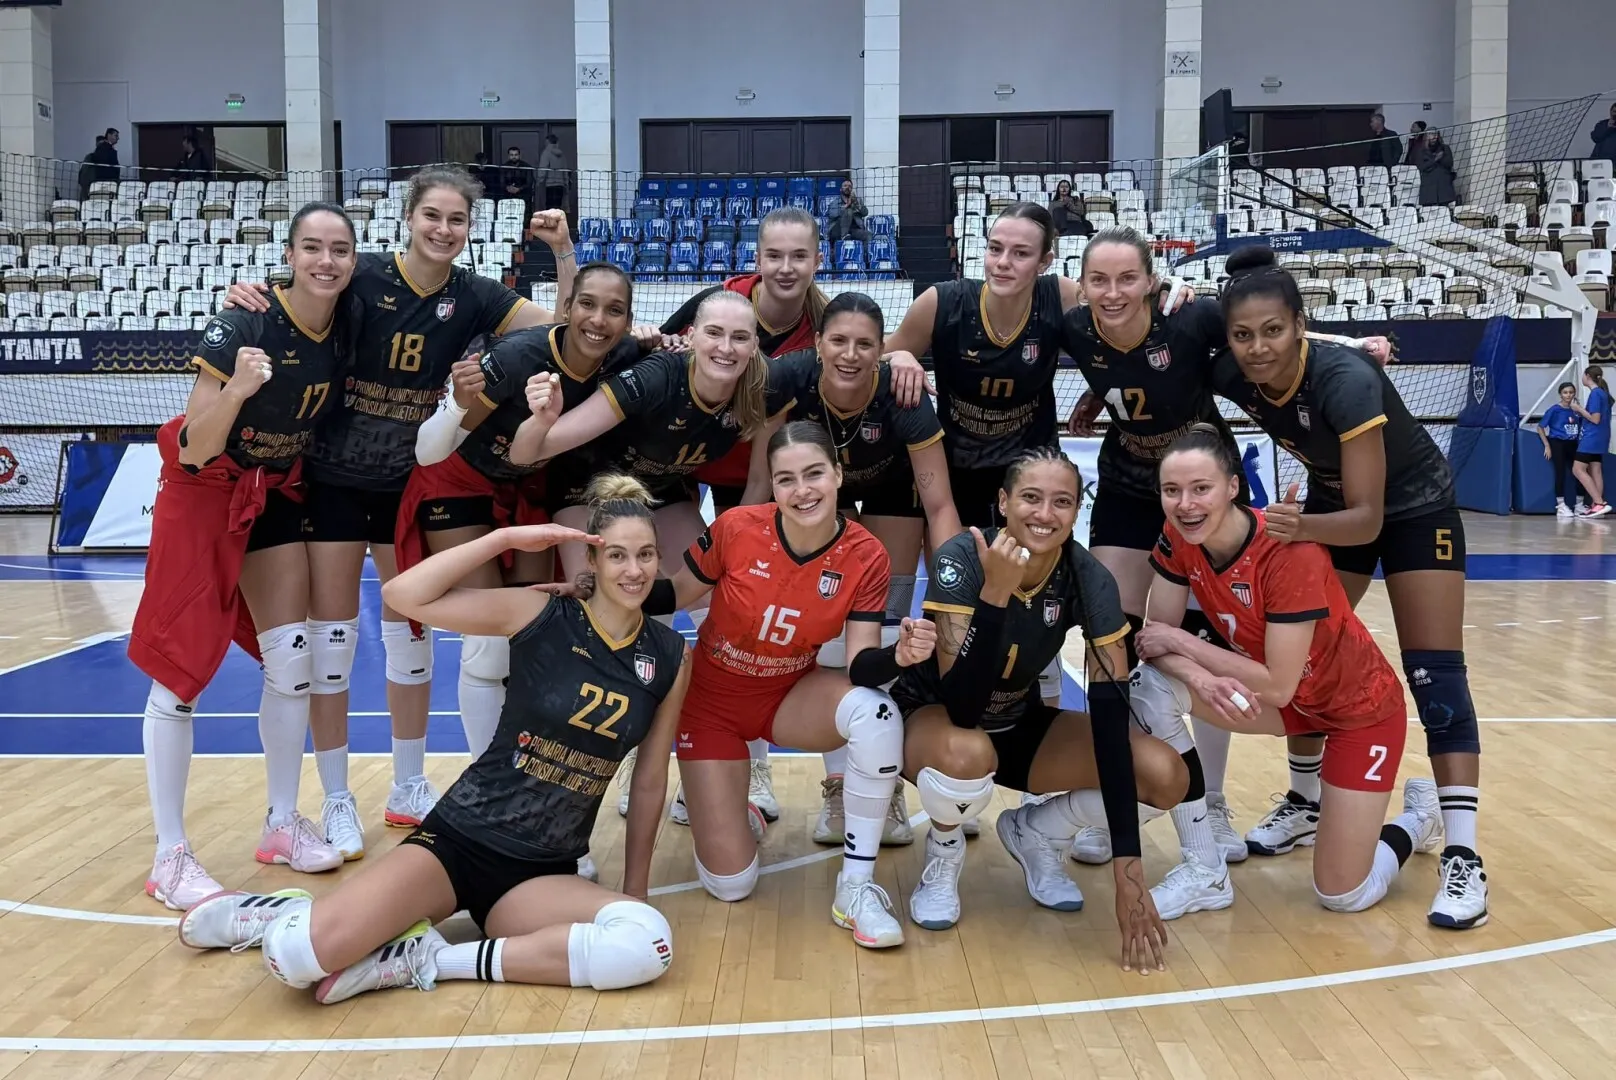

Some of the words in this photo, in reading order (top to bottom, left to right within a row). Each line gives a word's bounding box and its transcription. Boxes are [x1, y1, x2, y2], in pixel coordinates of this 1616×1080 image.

[0, 338, 83, 364] TANȚA
[388, 332, 425, 371] 18
[295, 382, 330, 419] 17
[1104, 387, 1153, 421] 12
[674, 442, 708, 466] 14
[1435, 529, 1453, 561] 5
[748, 567, 771, 579] erima
[758, 604, 801, 646] 15
[960, 626, 977, 658] KIPSTA
[1002, 643, 1019, 680] 1
[567, 682, 630, 740] 22
[1364, 744, 1388, 781] 2
